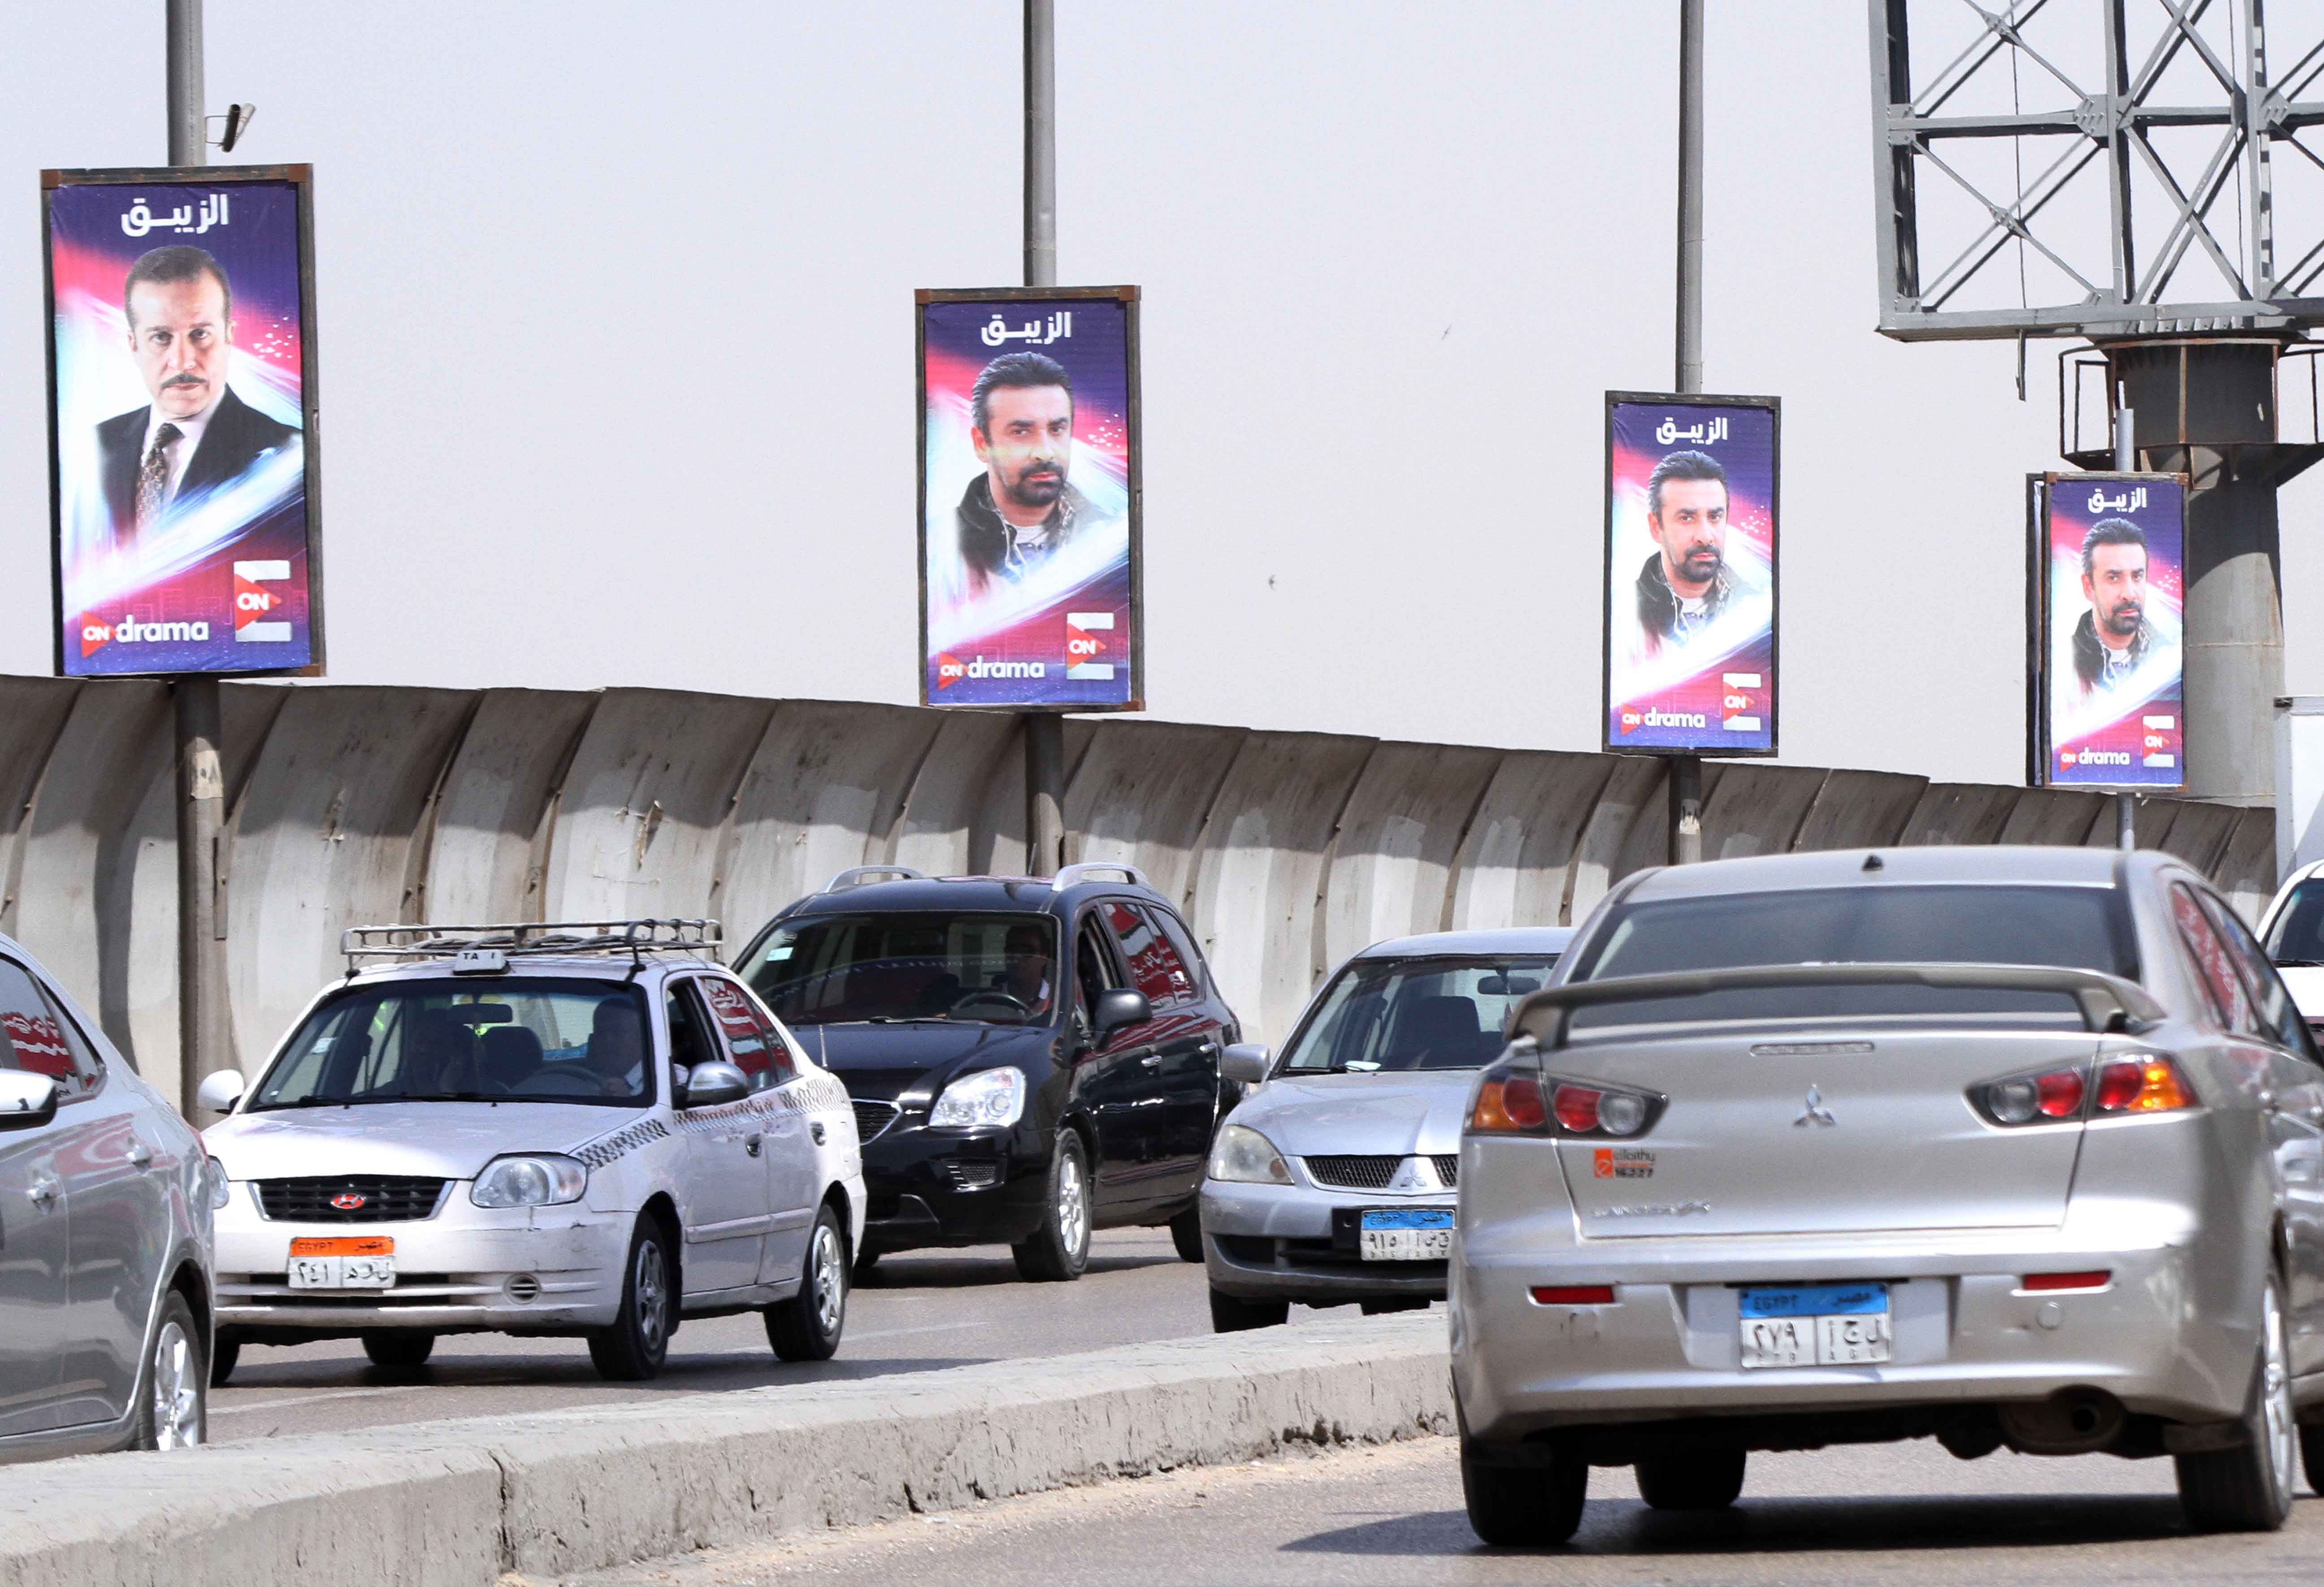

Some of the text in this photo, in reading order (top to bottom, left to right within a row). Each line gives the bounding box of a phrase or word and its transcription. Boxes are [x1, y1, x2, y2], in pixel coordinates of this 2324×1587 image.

[121, 194, 229, 237] الزيبق
[981, 311, 1072, 346] الزيبق
[1656, 417, 1728, 445] الزيبق
[2087, 487, 2147, 514] الزيبق
[237, 592, 270, 610] ON
[82, 614, 209, 643] ON drama
[1069, 640, 1096, 654] ON
[941, 655, 1045, 678] ON drama
[1724, 695, 1746, 709] ON
[1622, 706, 1706, 728] ON drama
[2061, 746, 2130, 765] ON drama
[298, 1241, 334, 1253] EGYPT
